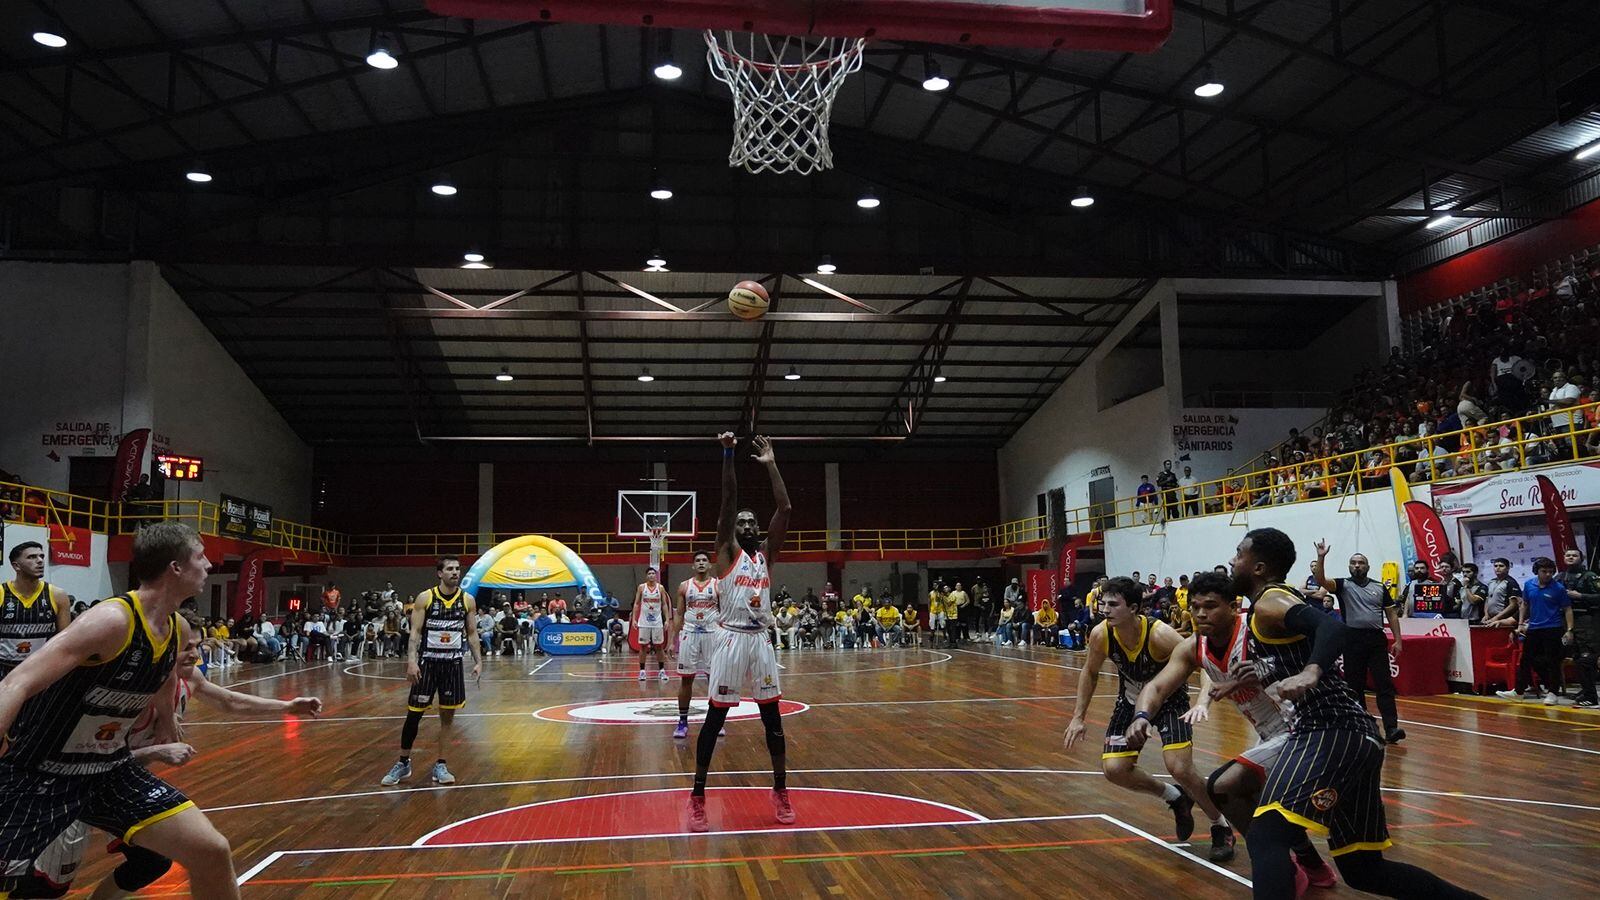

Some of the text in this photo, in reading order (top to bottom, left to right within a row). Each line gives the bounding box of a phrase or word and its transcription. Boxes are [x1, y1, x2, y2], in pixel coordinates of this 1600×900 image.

[1183, 415, 1226, 424] SALIDA DE
[56, 422, 110, 432] SALIDA DE
[1173, 425, 1236, 437] EMERGENCIA
[42, 434, 120, 446] EMERGENCIA
[1178, 440, 1233, 451] SANITARIOS
[1500, 485, 1577, 510] San Rón
[289, 599, 301, 610] 14
[565, 634, 595, 643] SPORTS
